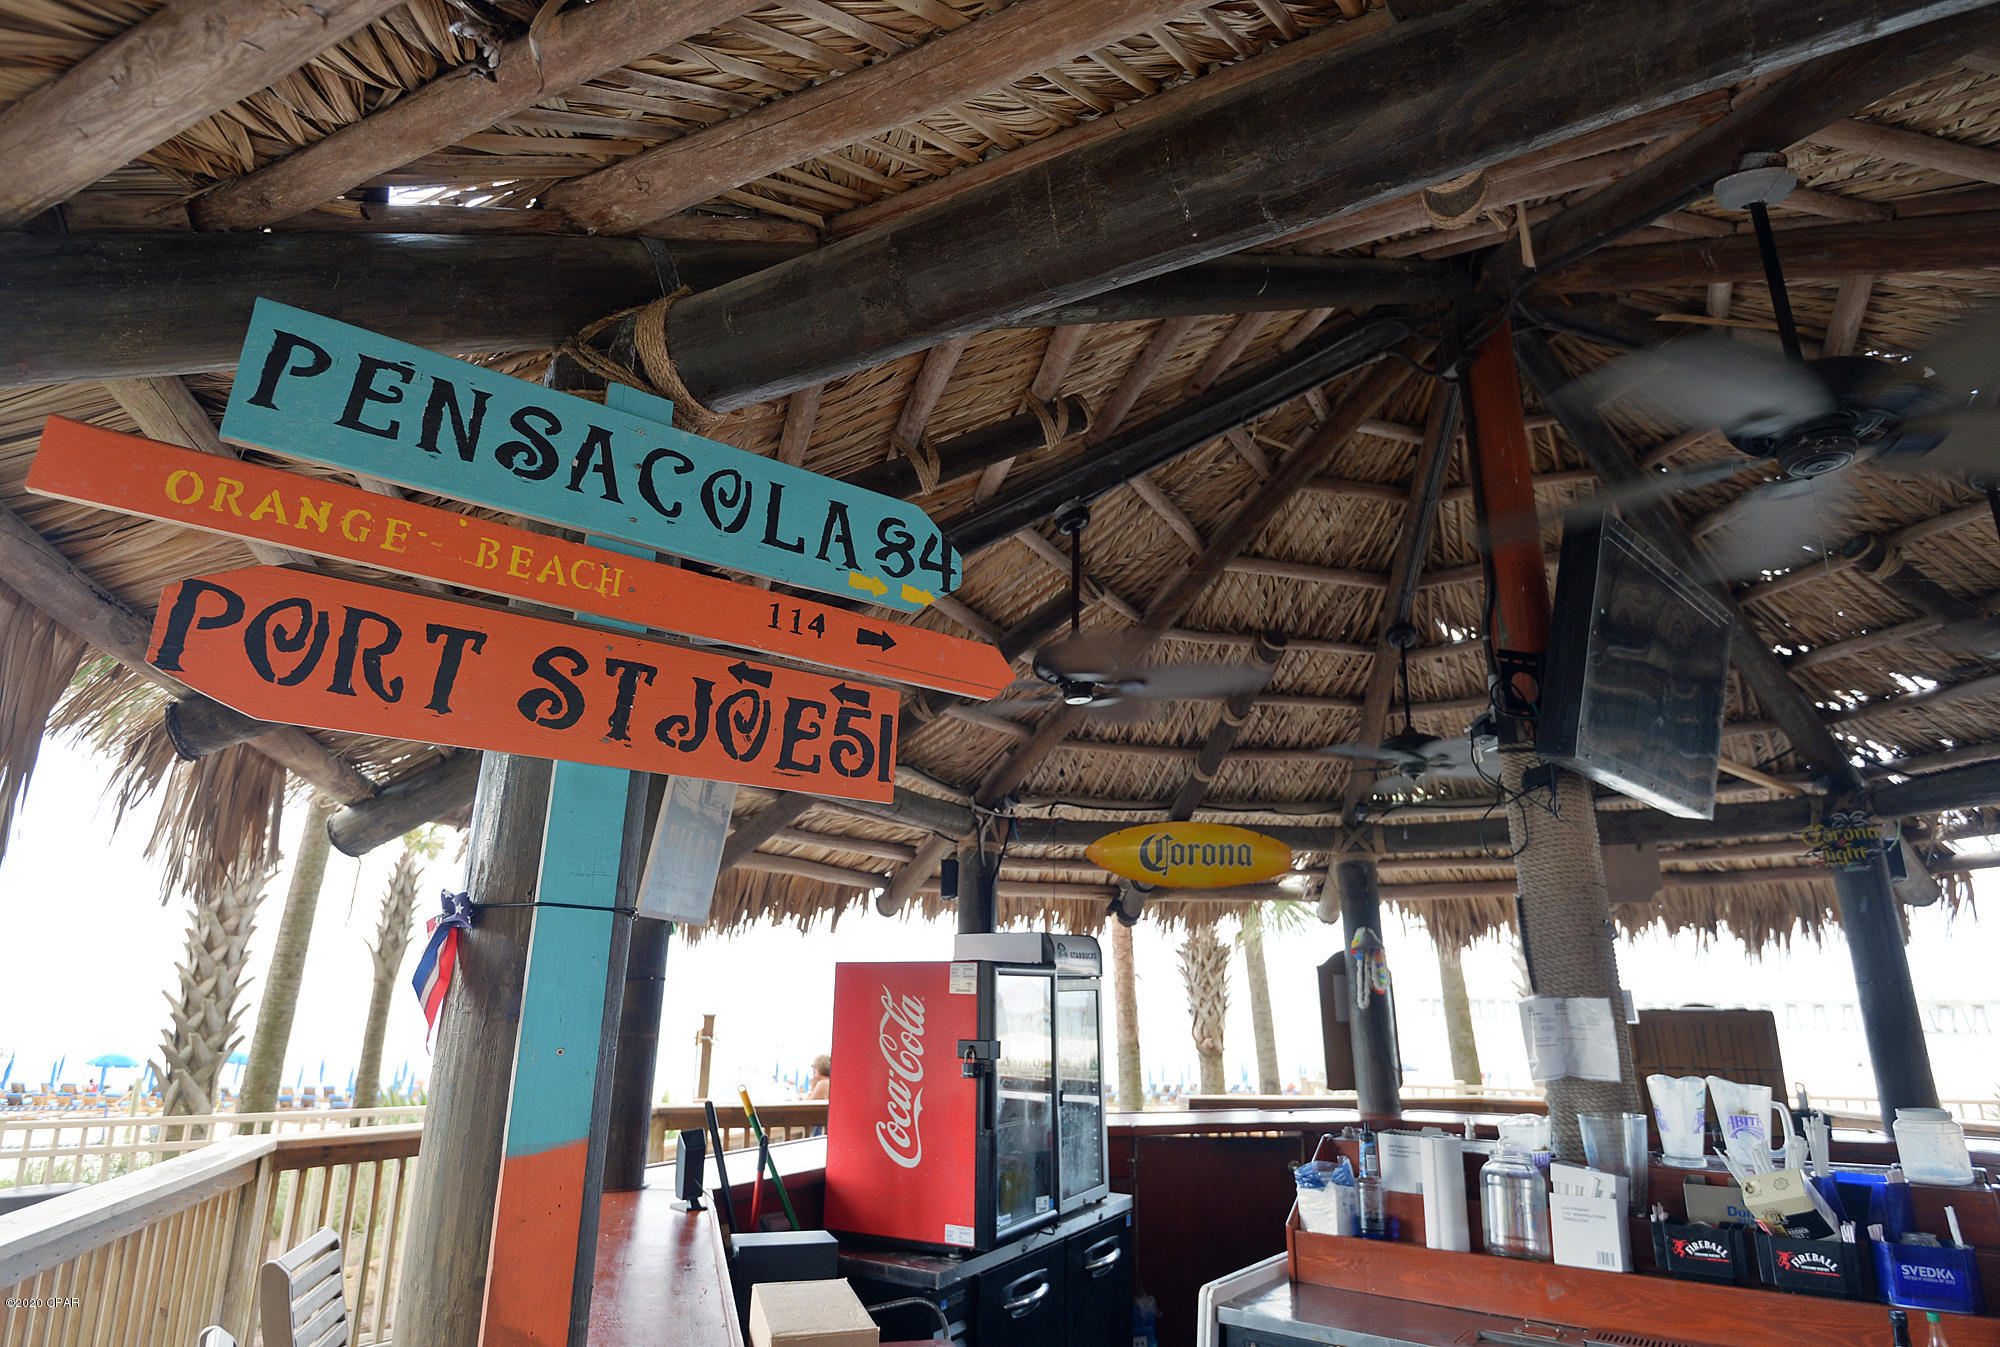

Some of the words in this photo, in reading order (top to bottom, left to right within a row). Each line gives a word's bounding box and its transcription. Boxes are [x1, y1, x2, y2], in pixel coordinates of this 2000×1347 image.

[246, 328, 863, 572] PENSACOLA
[875, 516, 958, 592] 84
[164, 469, 412, 554] ORANGE
[472, 536, 625, 598] BEACH
[767, 602, 826, 639] 114
[148, 578, 488, 715] PORT
[1802, 824, 1880, 847] Corona
[1139, 832, 1255, 877] Corona
[1069, 951, 1097, 960] STARBUCKS
[1684, 1239, 1730, 1258] FIREBALL
[1790, 1252, 1839, 1272] FIREBALL
[1901, 1264, 1955, 1280] SVEDKA
